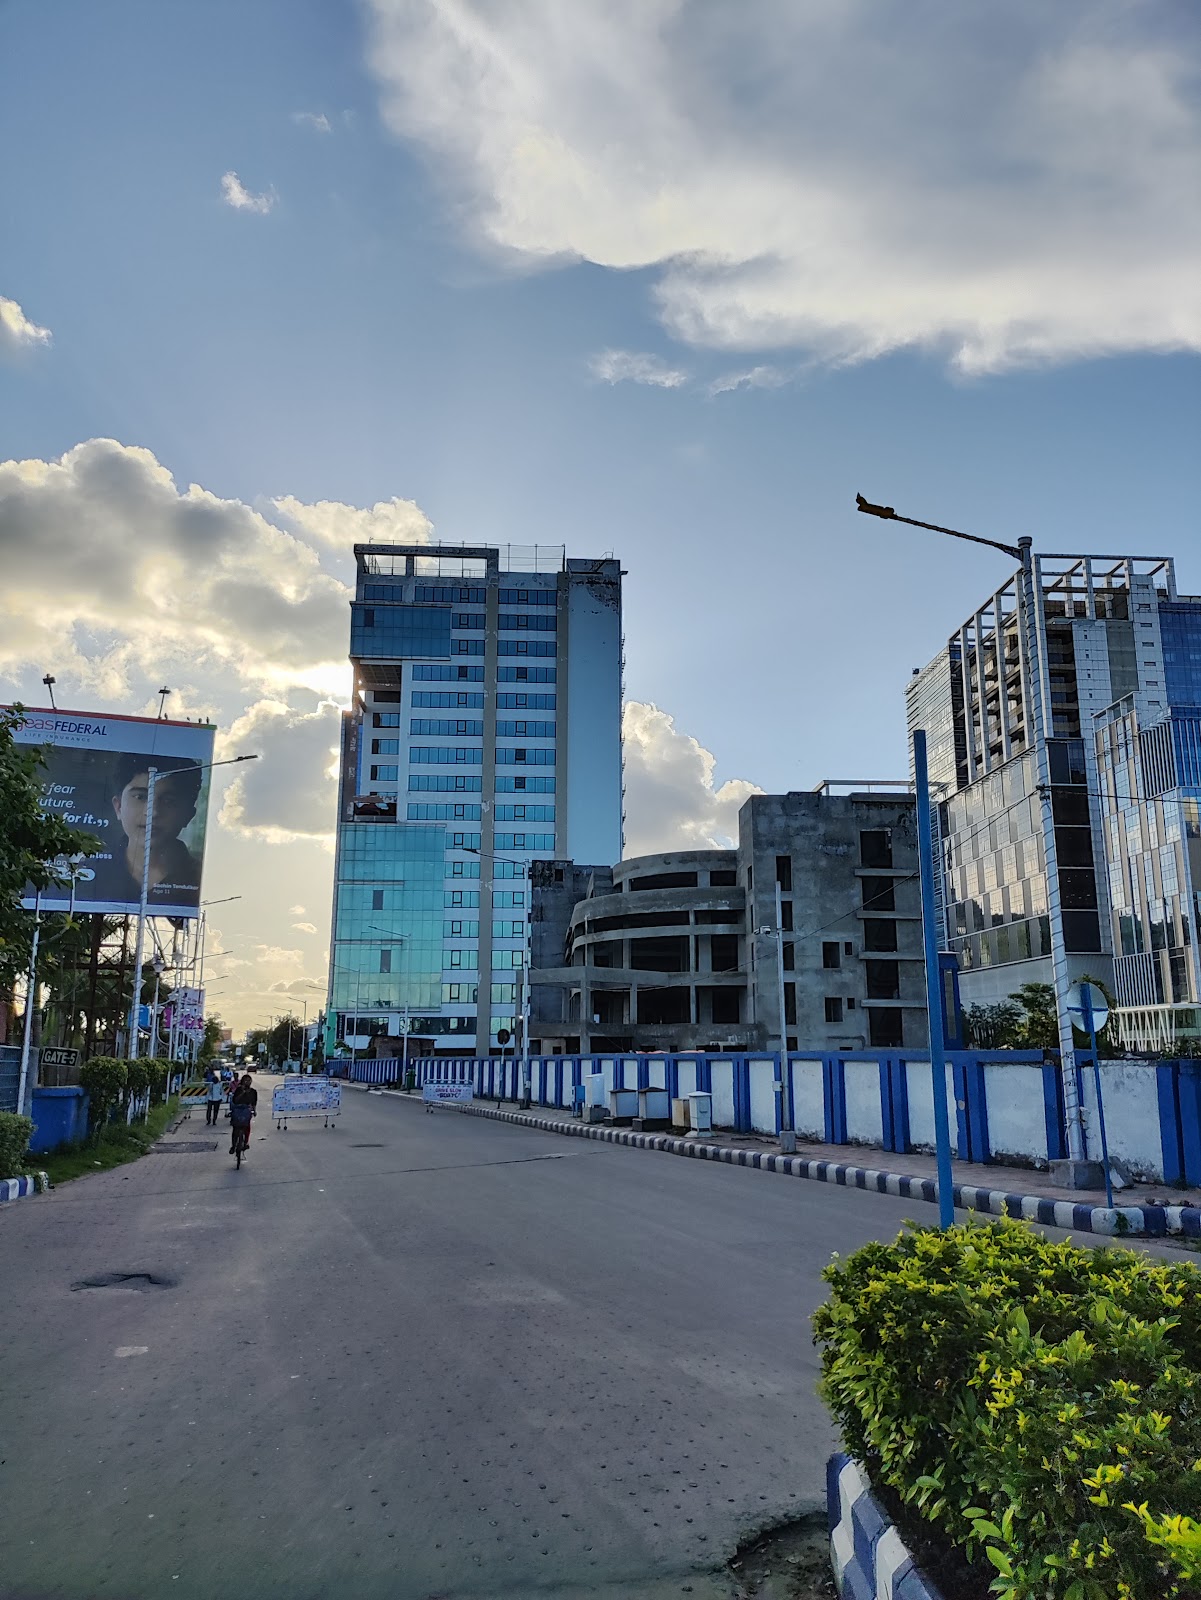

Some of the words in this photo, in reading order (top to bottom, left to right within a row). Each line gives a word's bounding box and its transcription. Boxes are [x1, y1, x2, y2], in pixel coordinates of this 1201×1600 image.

[46, 734, 91, 742] INSURANCE
[46, 782, 76, 795] fear
[36, 797, 76, 809] uture.
[62, 812, 81, 823] for
[44, 1050, 76, 1065] GATE-5
